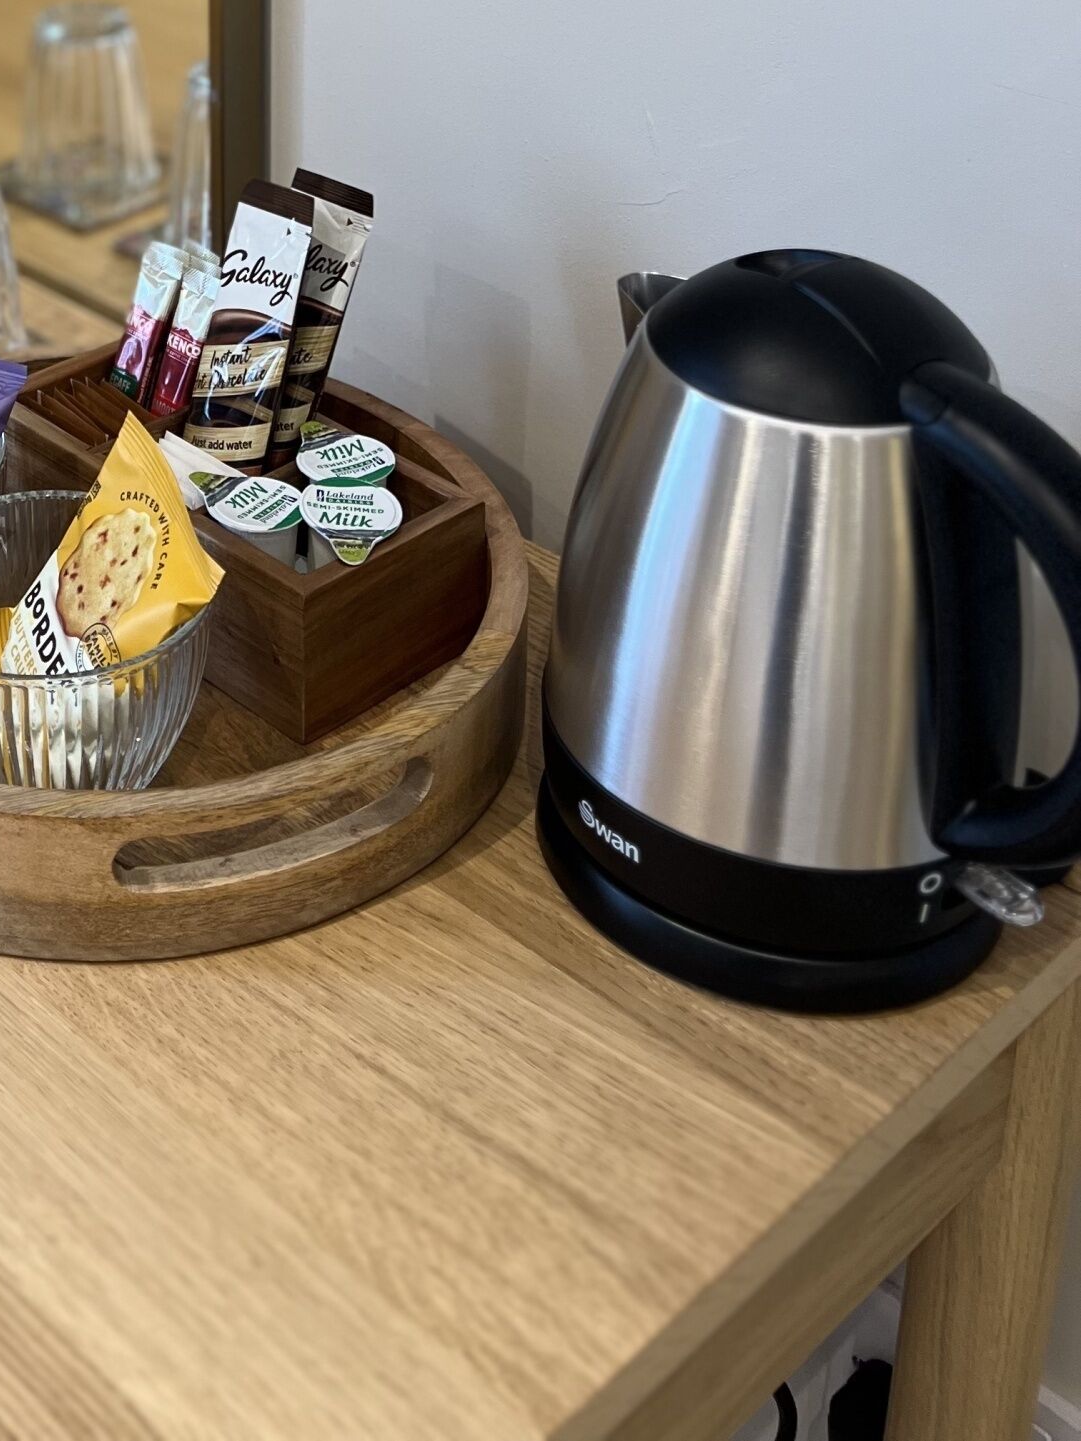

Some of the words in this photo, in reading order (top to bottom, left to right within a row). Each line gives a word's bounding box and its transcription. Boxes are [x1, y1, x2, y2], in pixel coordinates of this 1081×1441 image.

[220, 248, 294, 307] Galaxy
[167, 332, 201, 360] KENCO
[210, 345, 252, 369] Instant
[274, 421, 295, 432] ater
[191, 435, 207, 449] Just
[208, 439, 225, 450] add
[226, 440, 253, 450] water
[315, 438, 365, 462] Milk
[119, 491, 160, 513] CRAFTED
[225, 481, 269, 509] Milk
[306, 501, 385, 514] SEMI-SKIMMED
[326, 490, 374, 501] Lakeland
[157, 512, 170, 547] WITH
[318, 511, 374, 528] Milk
[150, 551, 168, 590] CARE
[24, 580, 71, 676] BORDE
[91, 630, 111, 667] FAMIL
[578, 799, 640, 864] Swan
